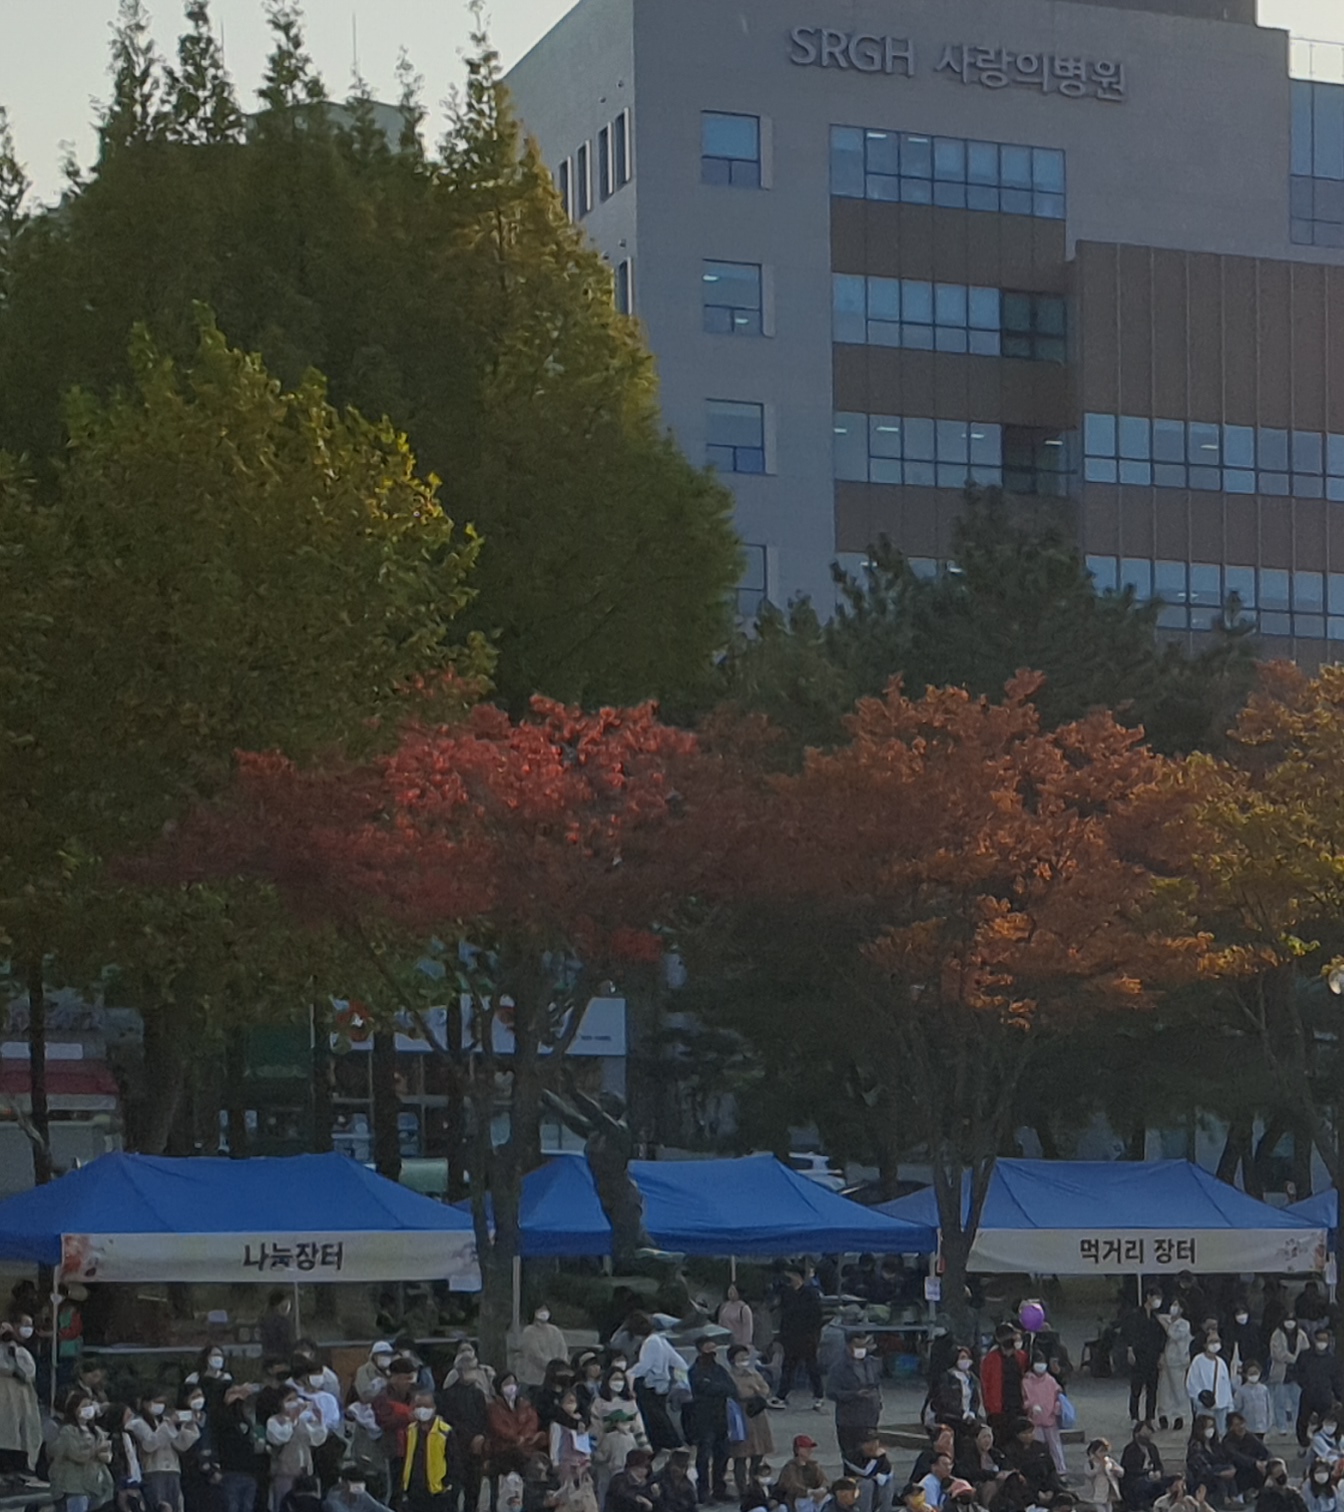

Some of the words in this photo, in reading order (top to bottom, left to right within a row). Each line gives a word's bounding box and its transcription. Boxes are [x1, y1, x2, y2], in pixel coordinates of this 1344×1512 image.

[789, 25, 916, 78] SRGH
[934, 43, 1127, 103] 사랑의병원
[1080, 1237, 1145, 1265] 먹거리
[1153, 1237, 1197, 1265] 장터
